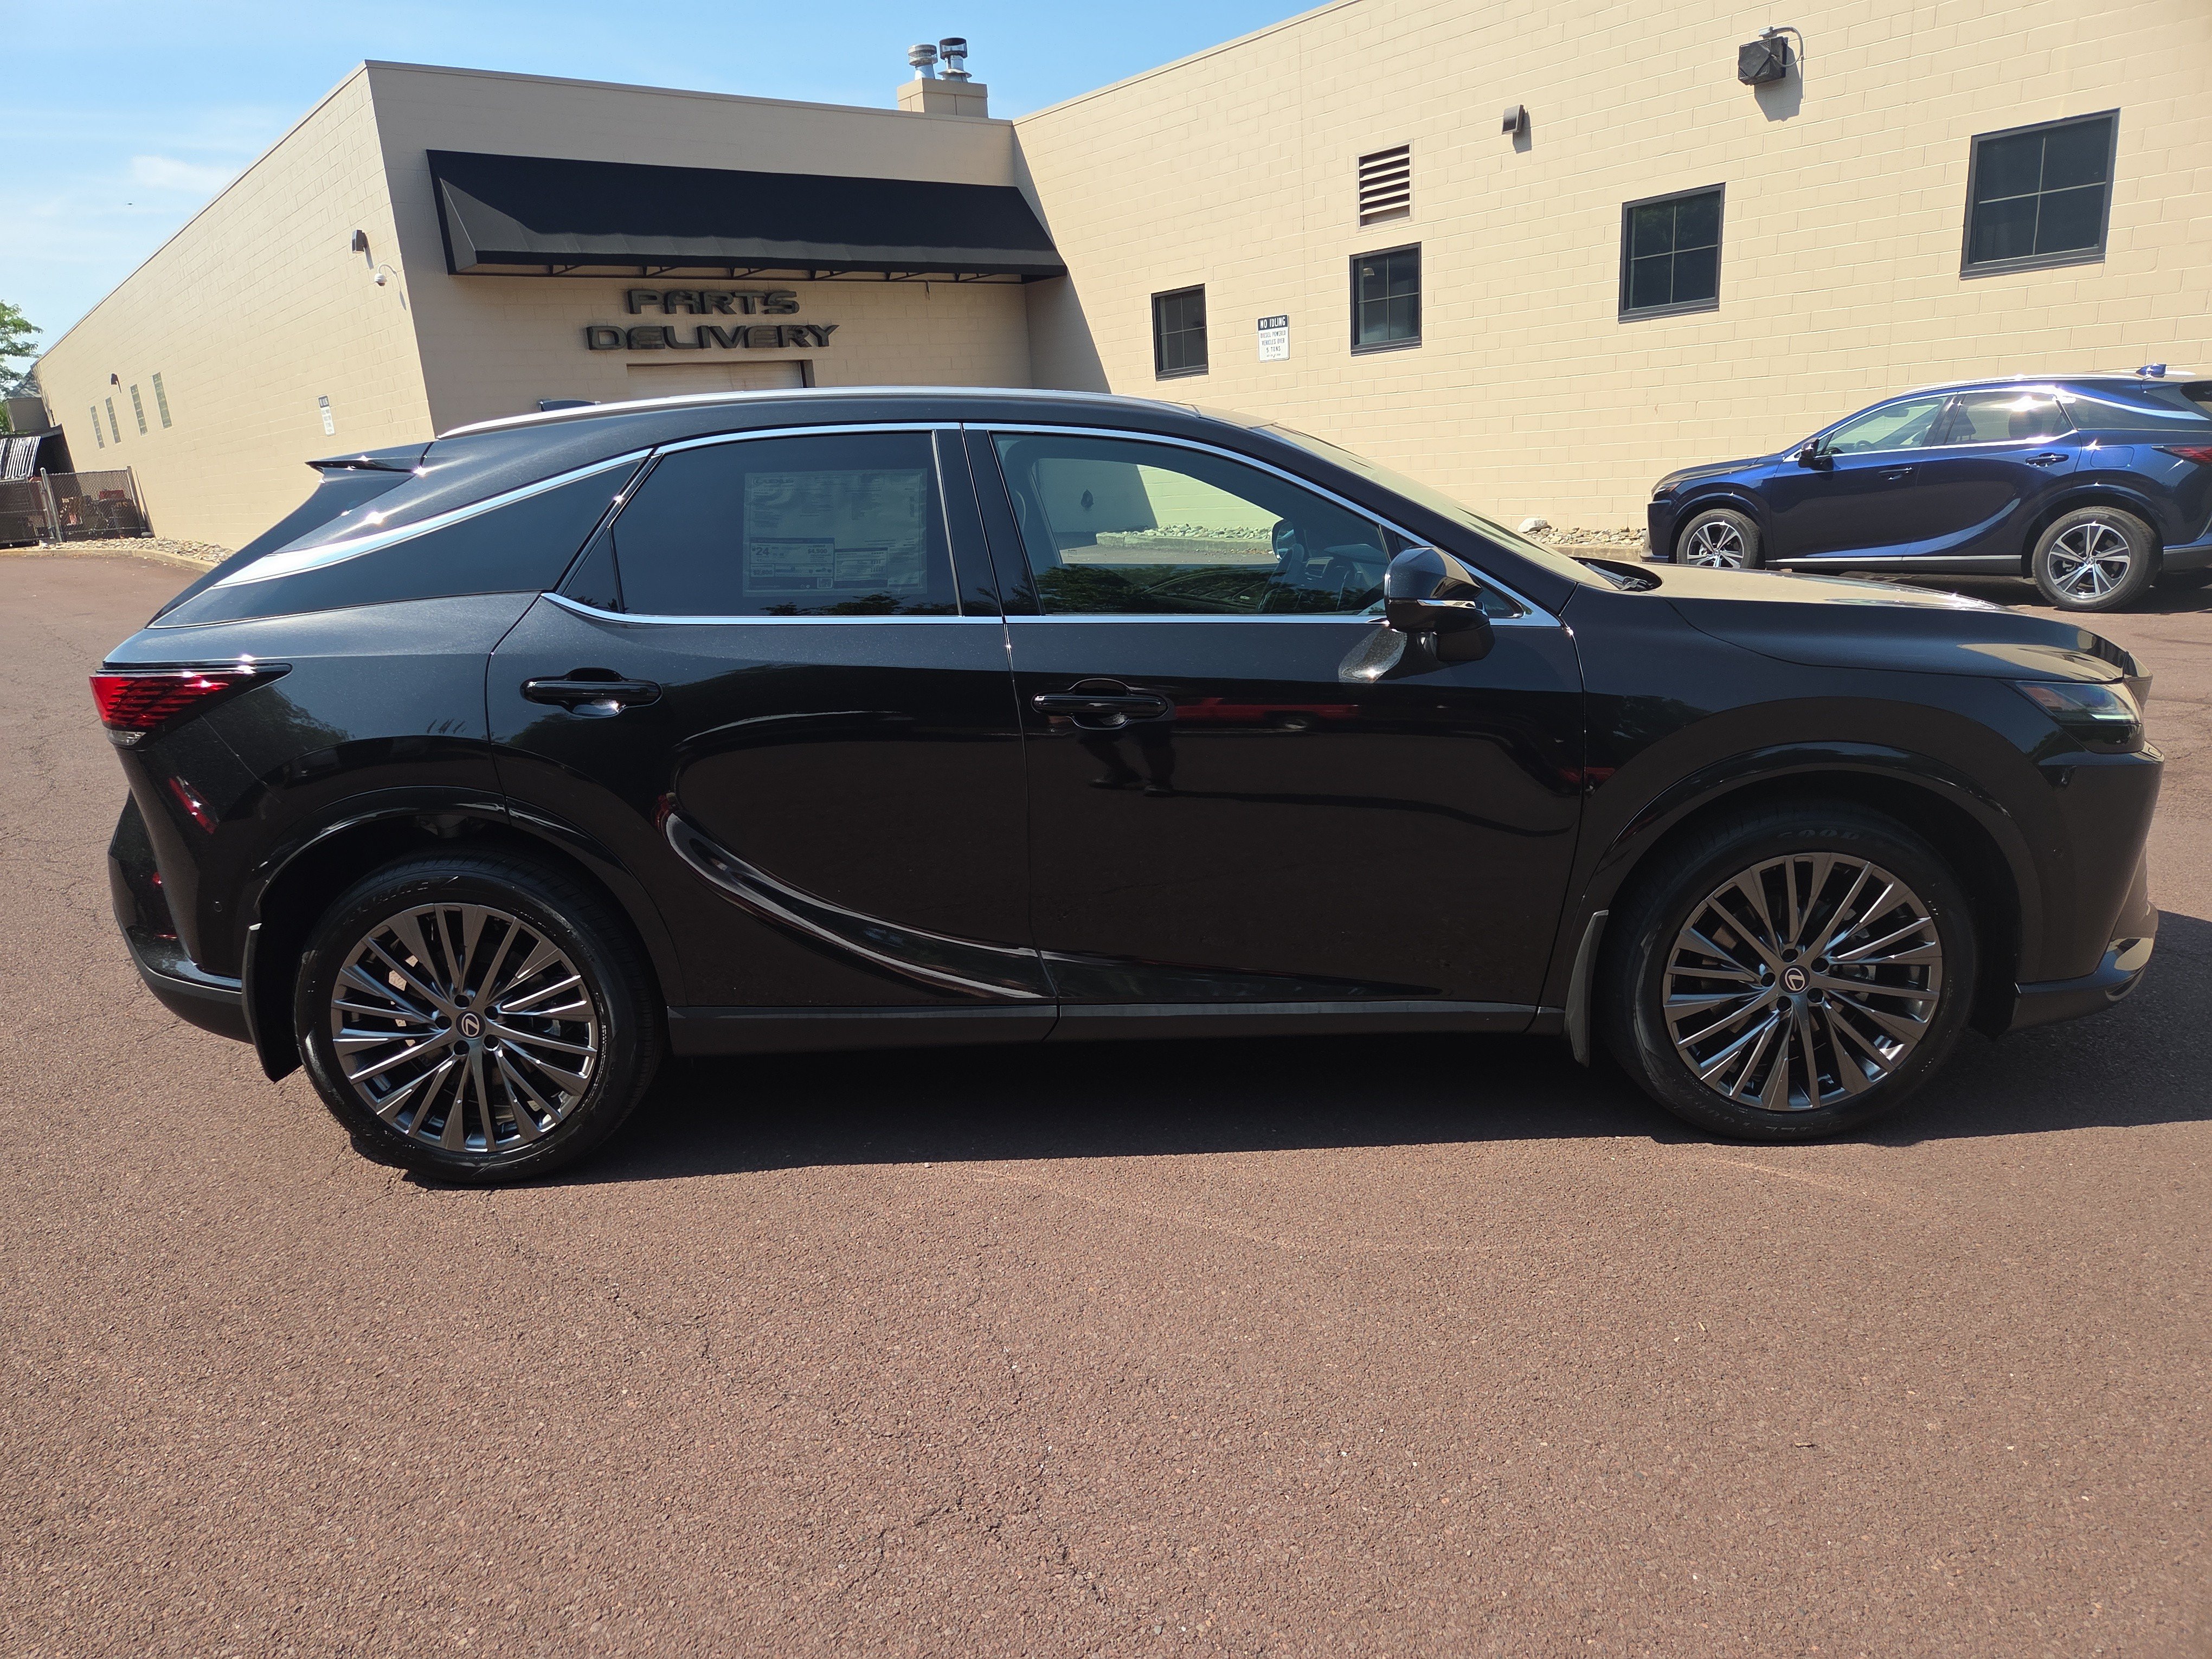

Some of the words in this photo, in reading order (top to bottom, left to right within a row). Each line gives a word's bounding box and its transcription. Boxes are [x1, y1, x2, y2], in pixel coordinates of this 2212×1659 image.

[627, 289, 800, 315] PARTS
[1260, 319, 1268, 329] NO
[1269, 317, 1285, 327] IDLING
[586, 325, 840, 350] DELIVERY
